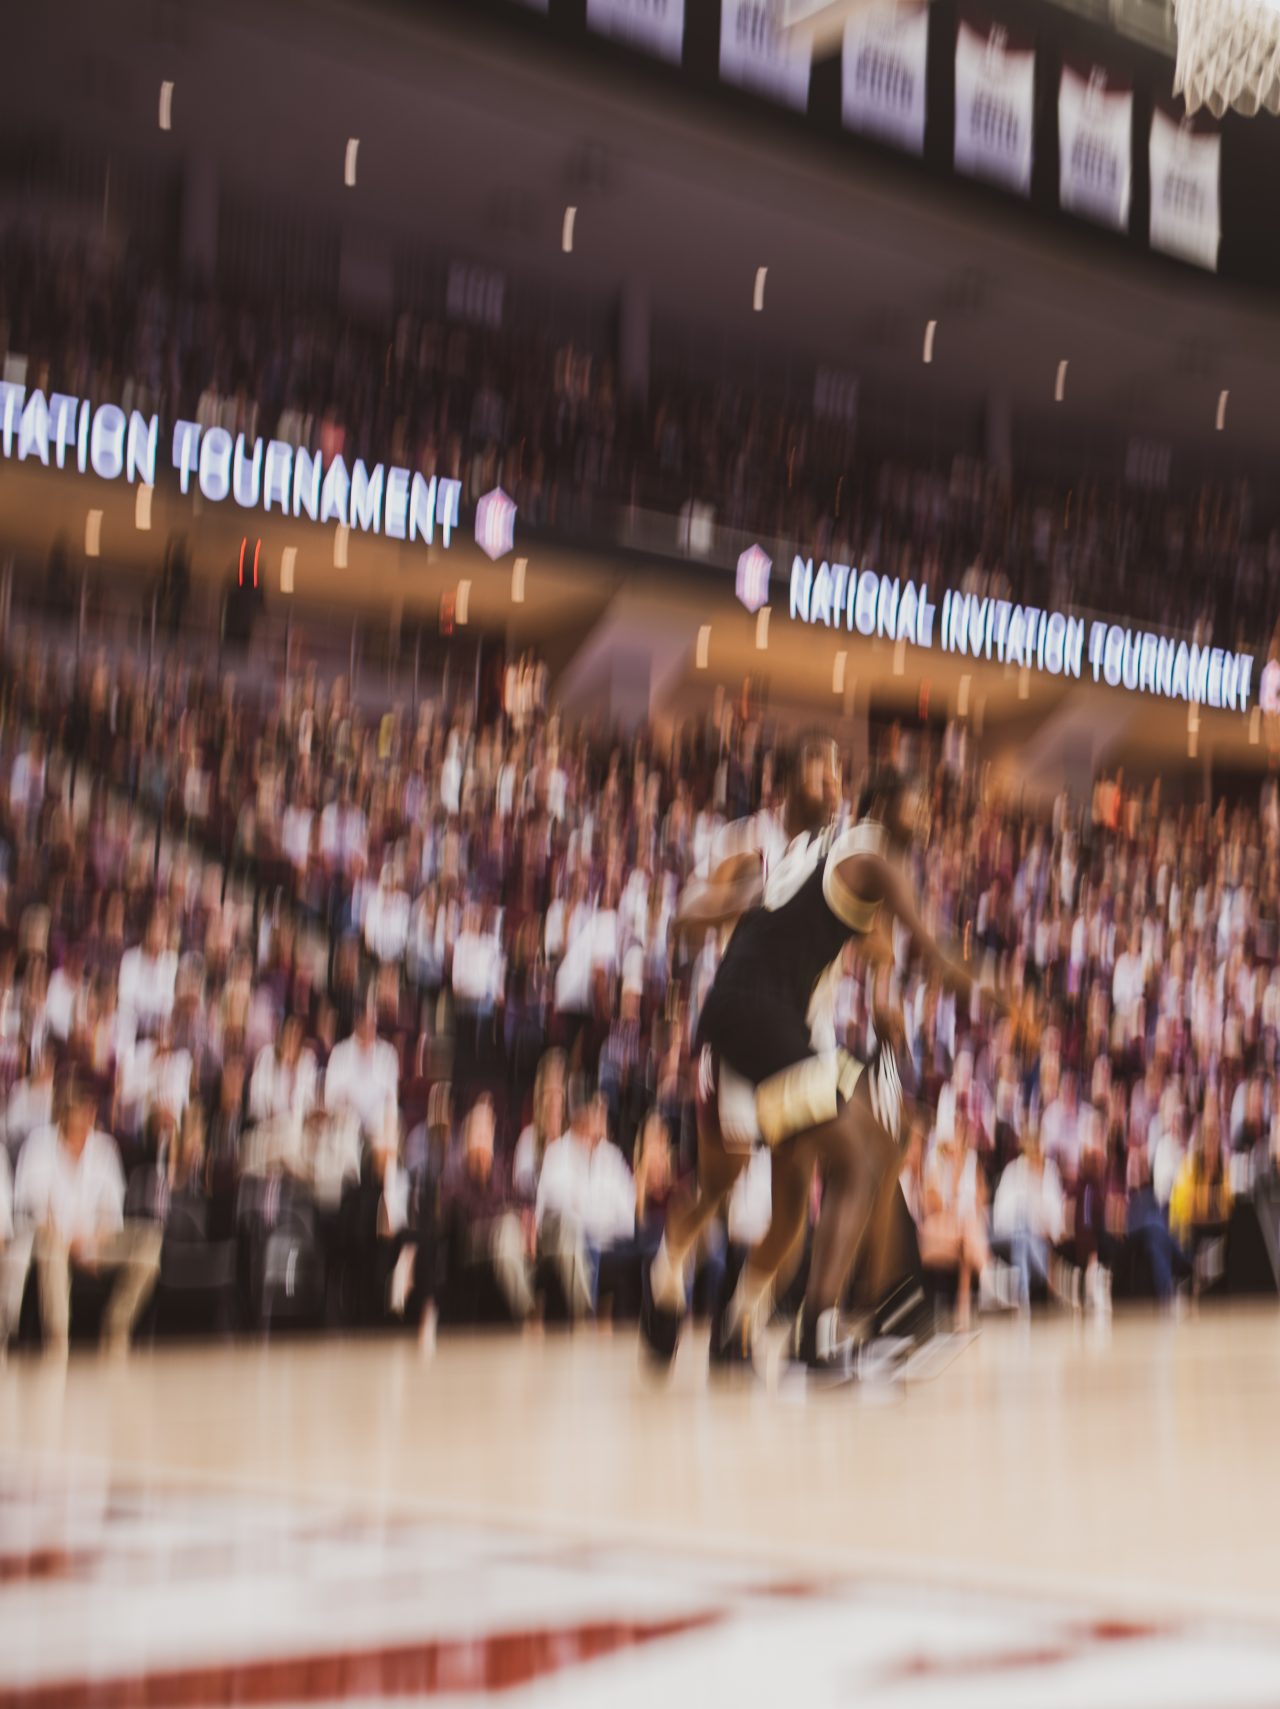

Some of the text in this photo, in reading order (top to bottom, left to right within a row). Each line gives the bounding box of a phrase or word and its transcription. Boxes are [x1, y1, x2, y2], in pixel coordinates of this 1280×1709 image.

[172, 419, 461, 549] TOURNAMENT
[789, 554, 1254, 713] NATIONAL INVITATION TOURNAMENT
